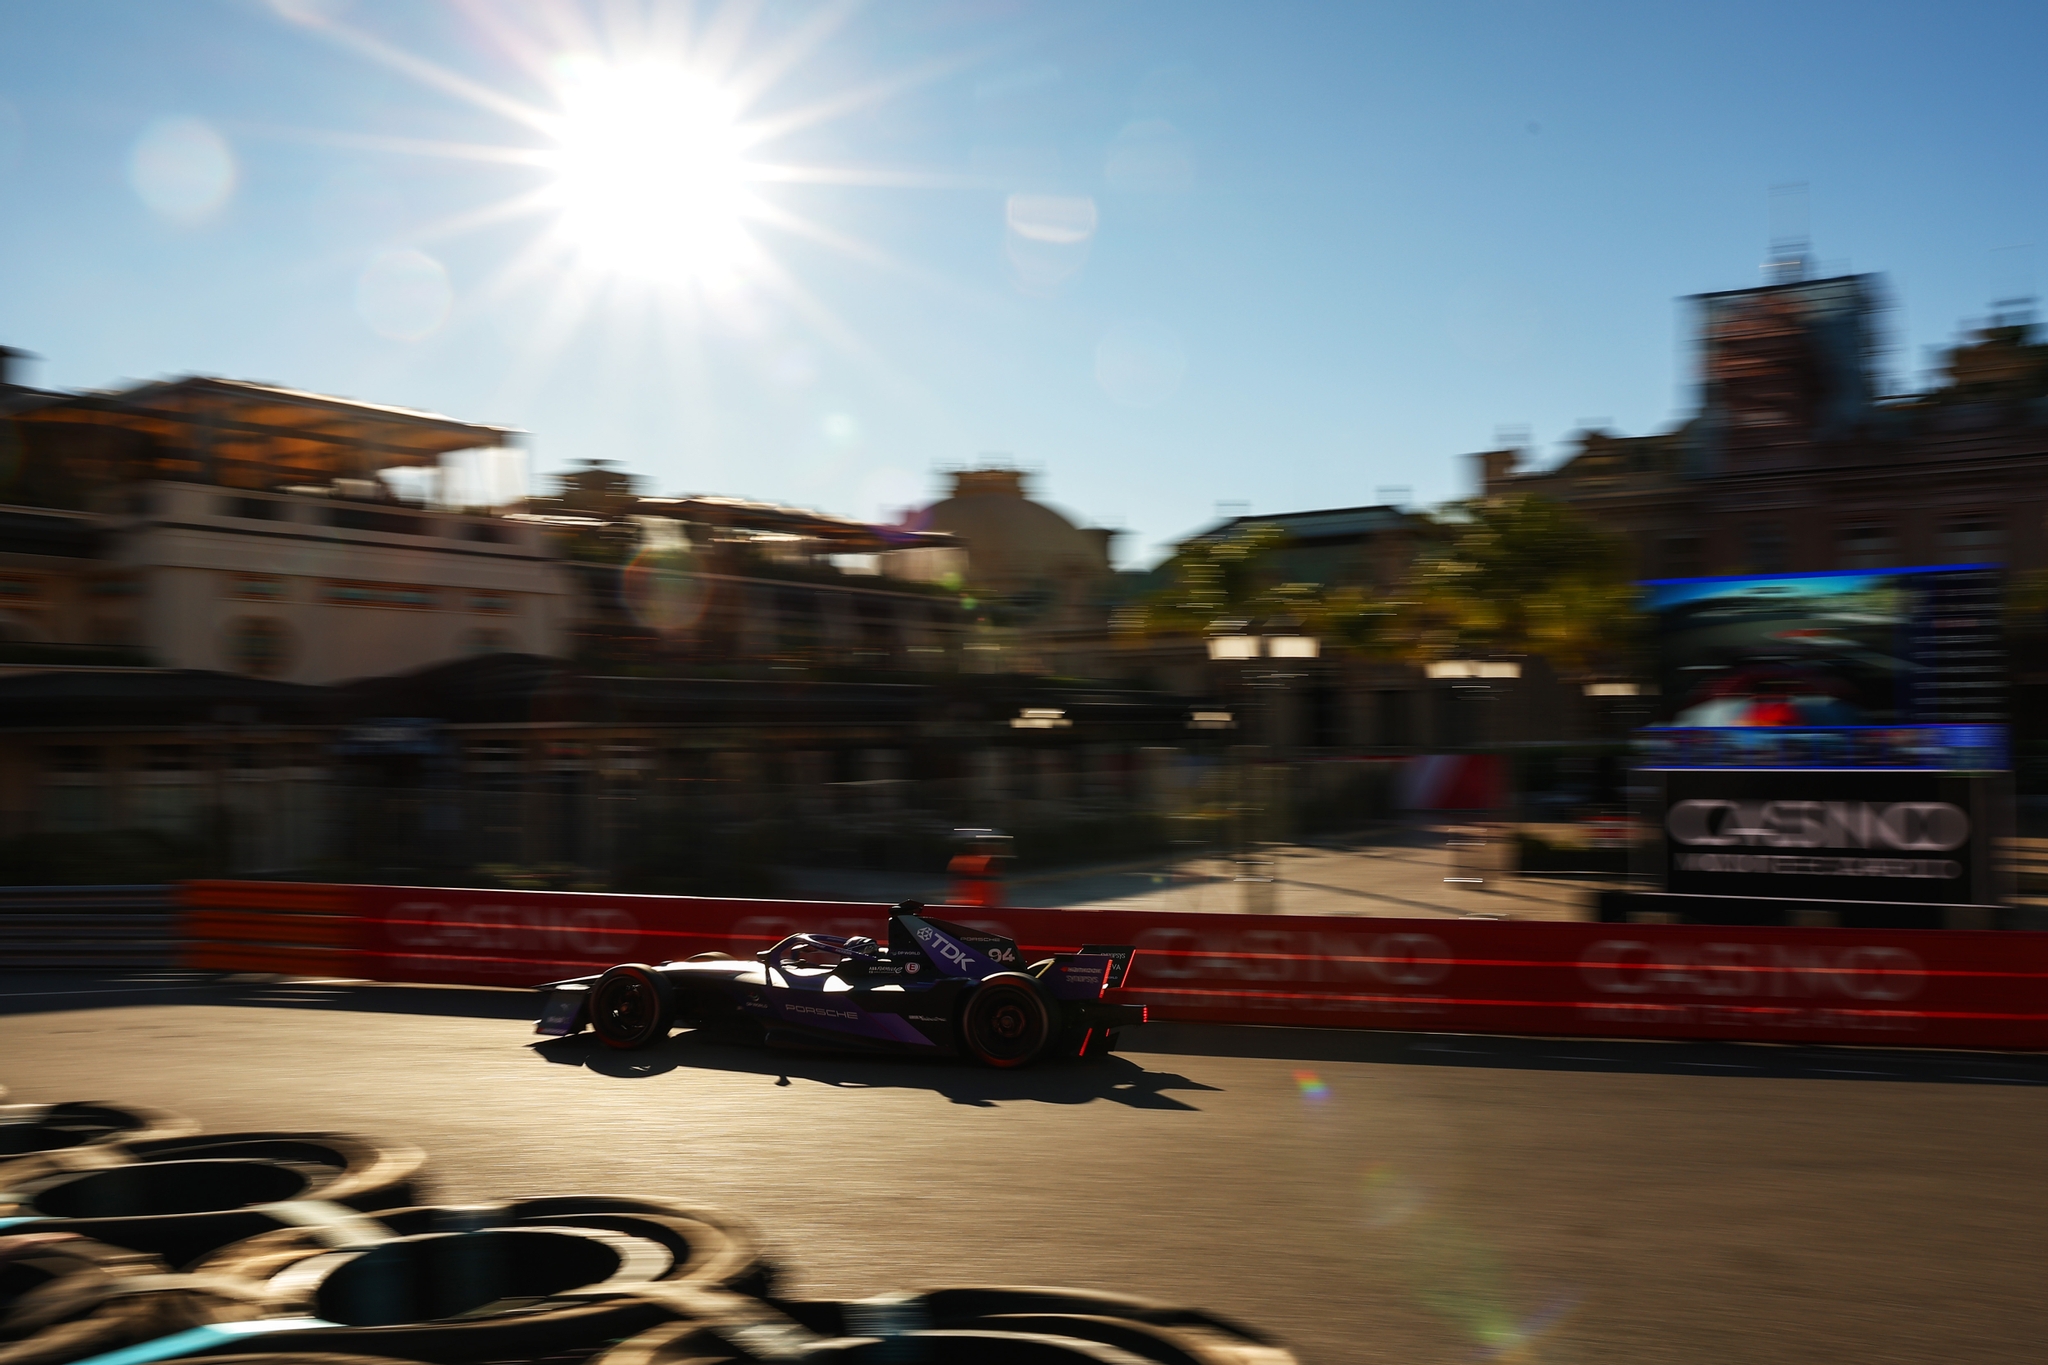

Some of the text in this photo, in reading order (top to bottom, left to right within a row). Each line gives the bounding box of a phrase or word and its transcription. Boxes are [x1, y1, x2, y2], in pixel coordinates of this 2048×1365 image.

[931, 932, 976, 972] TDK
[987, 947, 1016, 963] 94
[909, 963, 917, 971] E
[785, 1004, 859, 1020] PORSCHE
